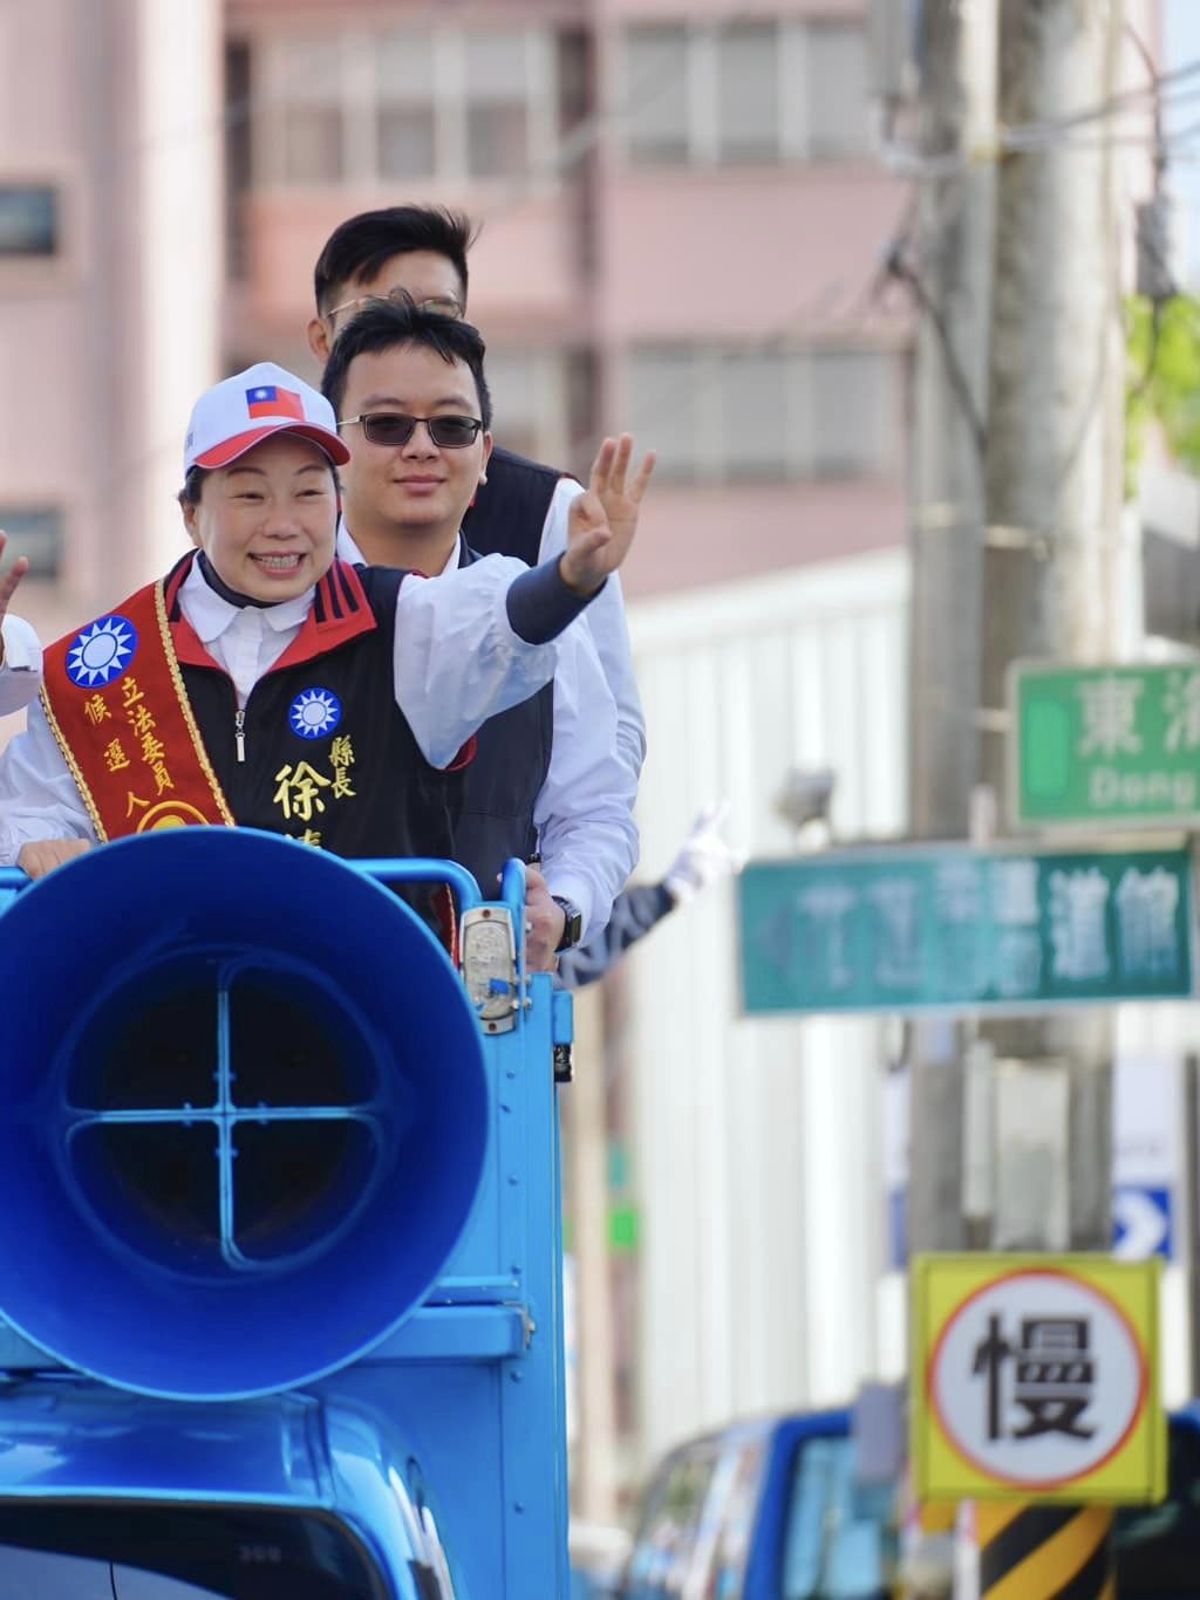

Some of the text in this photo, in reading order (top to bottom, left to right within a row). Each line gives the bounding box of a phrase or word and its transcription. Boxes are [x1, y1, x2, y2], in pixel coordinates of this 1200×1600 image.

[84, 694, 150, 818] 候選人
[121, 676, 175, 796] 立法委員
[328, 734, 357, 799] 縣長
[971, 1314, 1097, 1440] 慢
